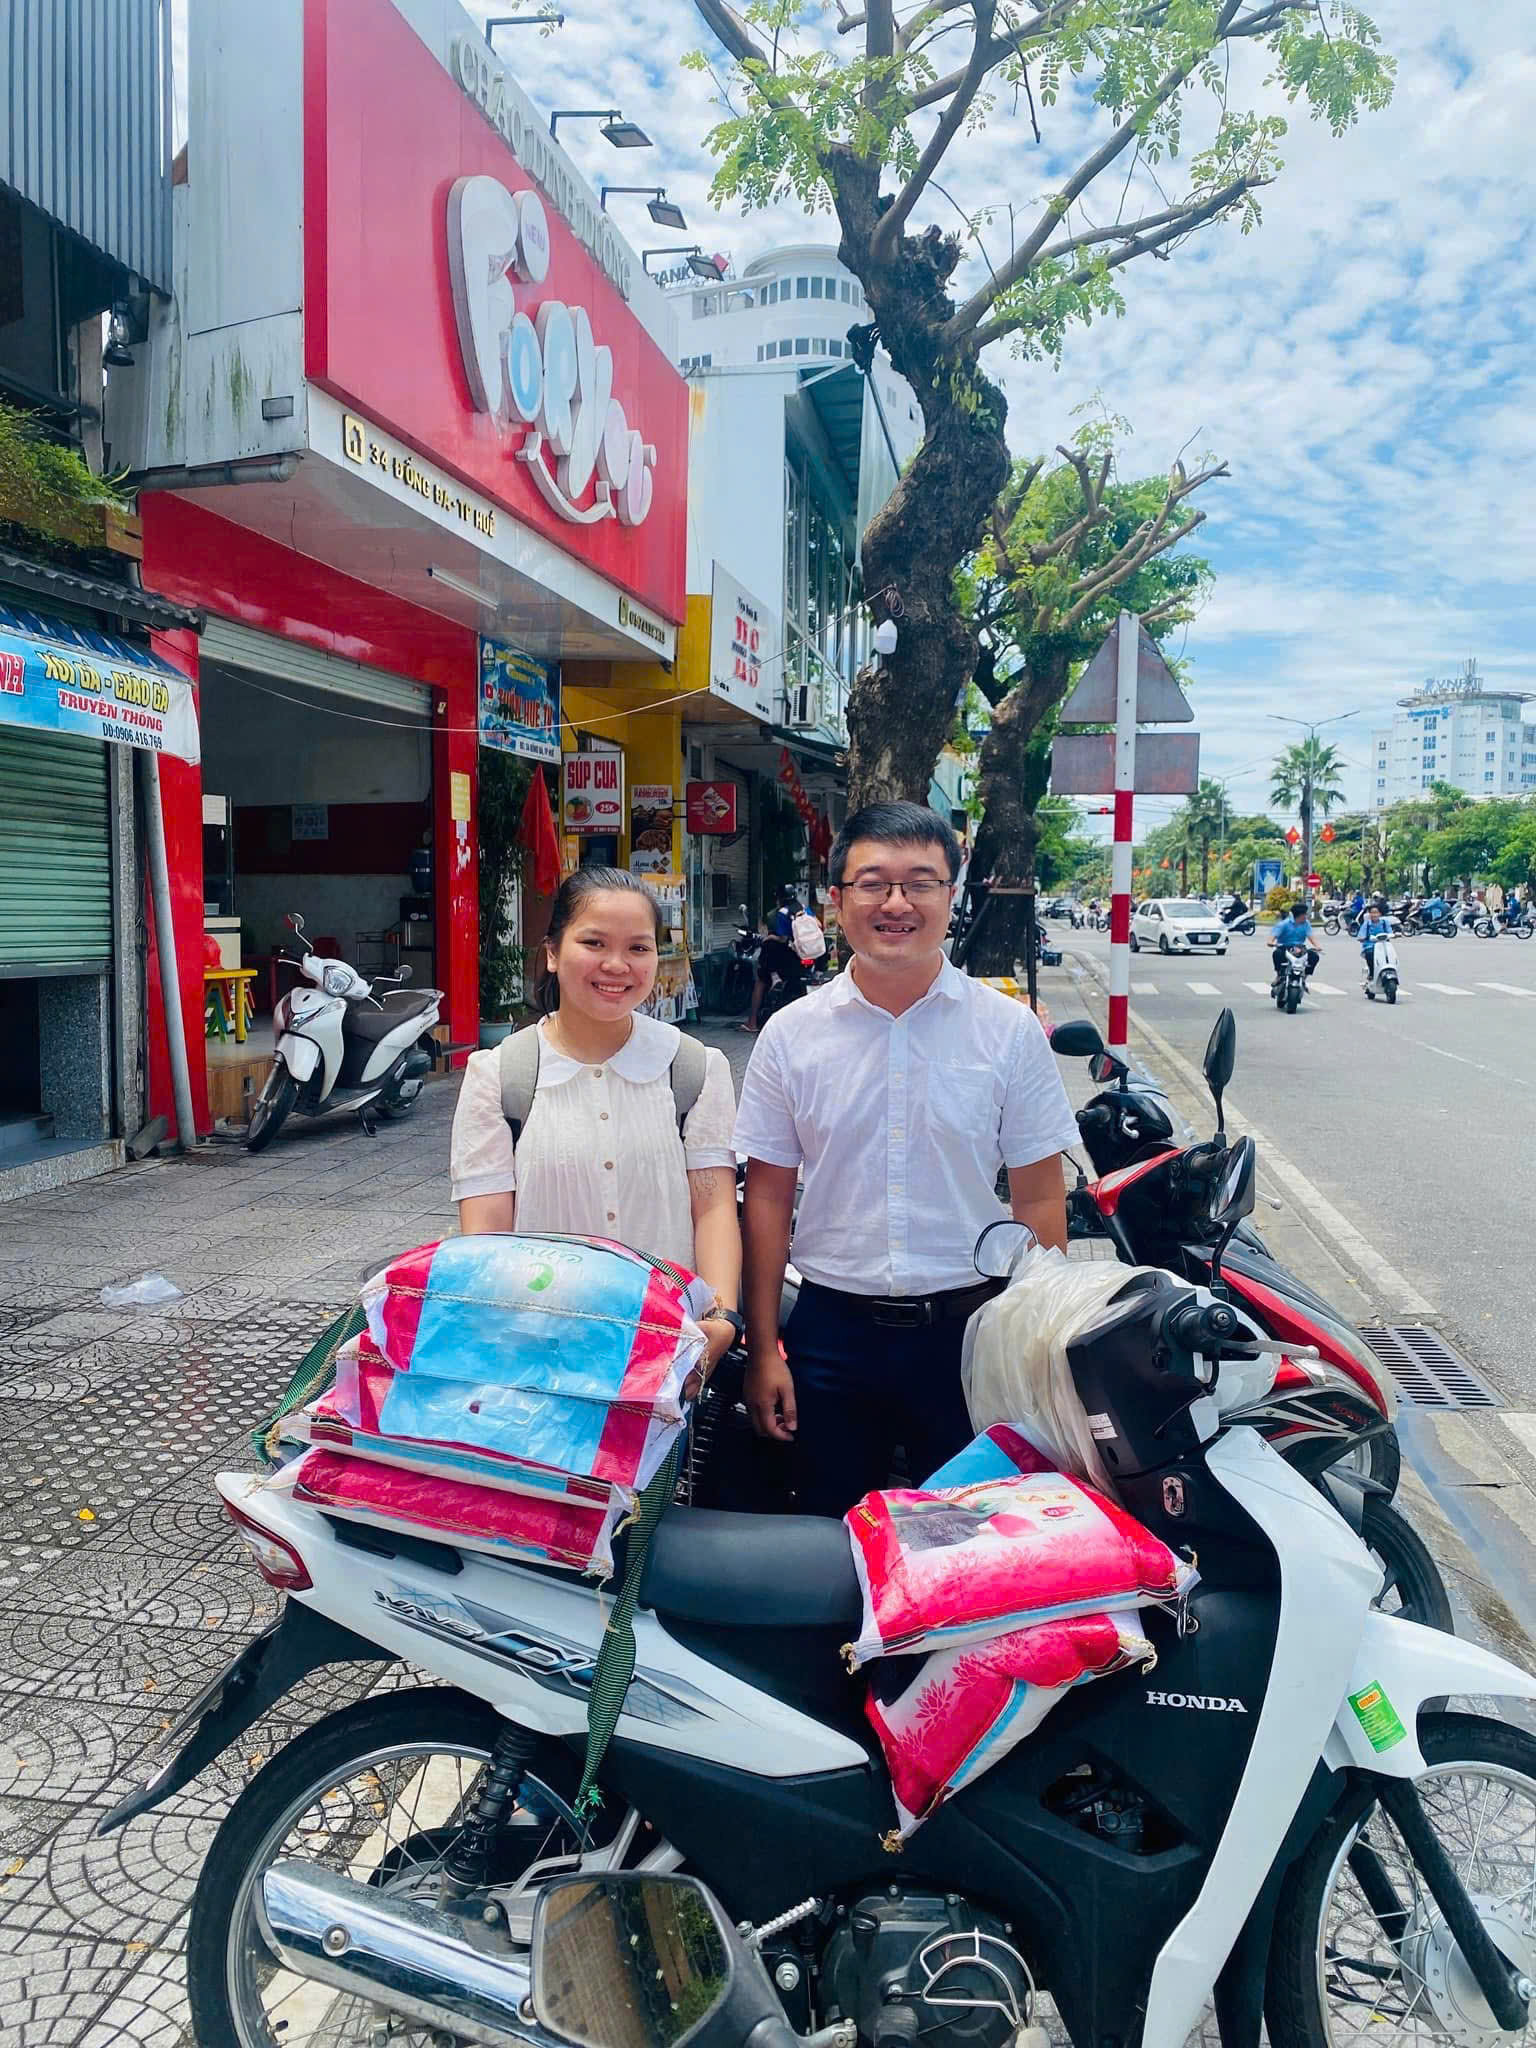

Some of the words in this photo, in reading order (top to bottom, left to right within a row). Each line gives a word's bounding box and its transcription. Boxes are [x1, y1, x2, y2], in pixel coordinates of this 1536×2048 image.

[370, 443, 389, 472] 34
[152, 679, 170, 714] GÀ
[121, 707, 163, 732] THỐNG
[567, 756, 591, 789] SÚP
[594, 760, 618, 789] CUA
[1146, 1690, 1248, 1713] HONDA
